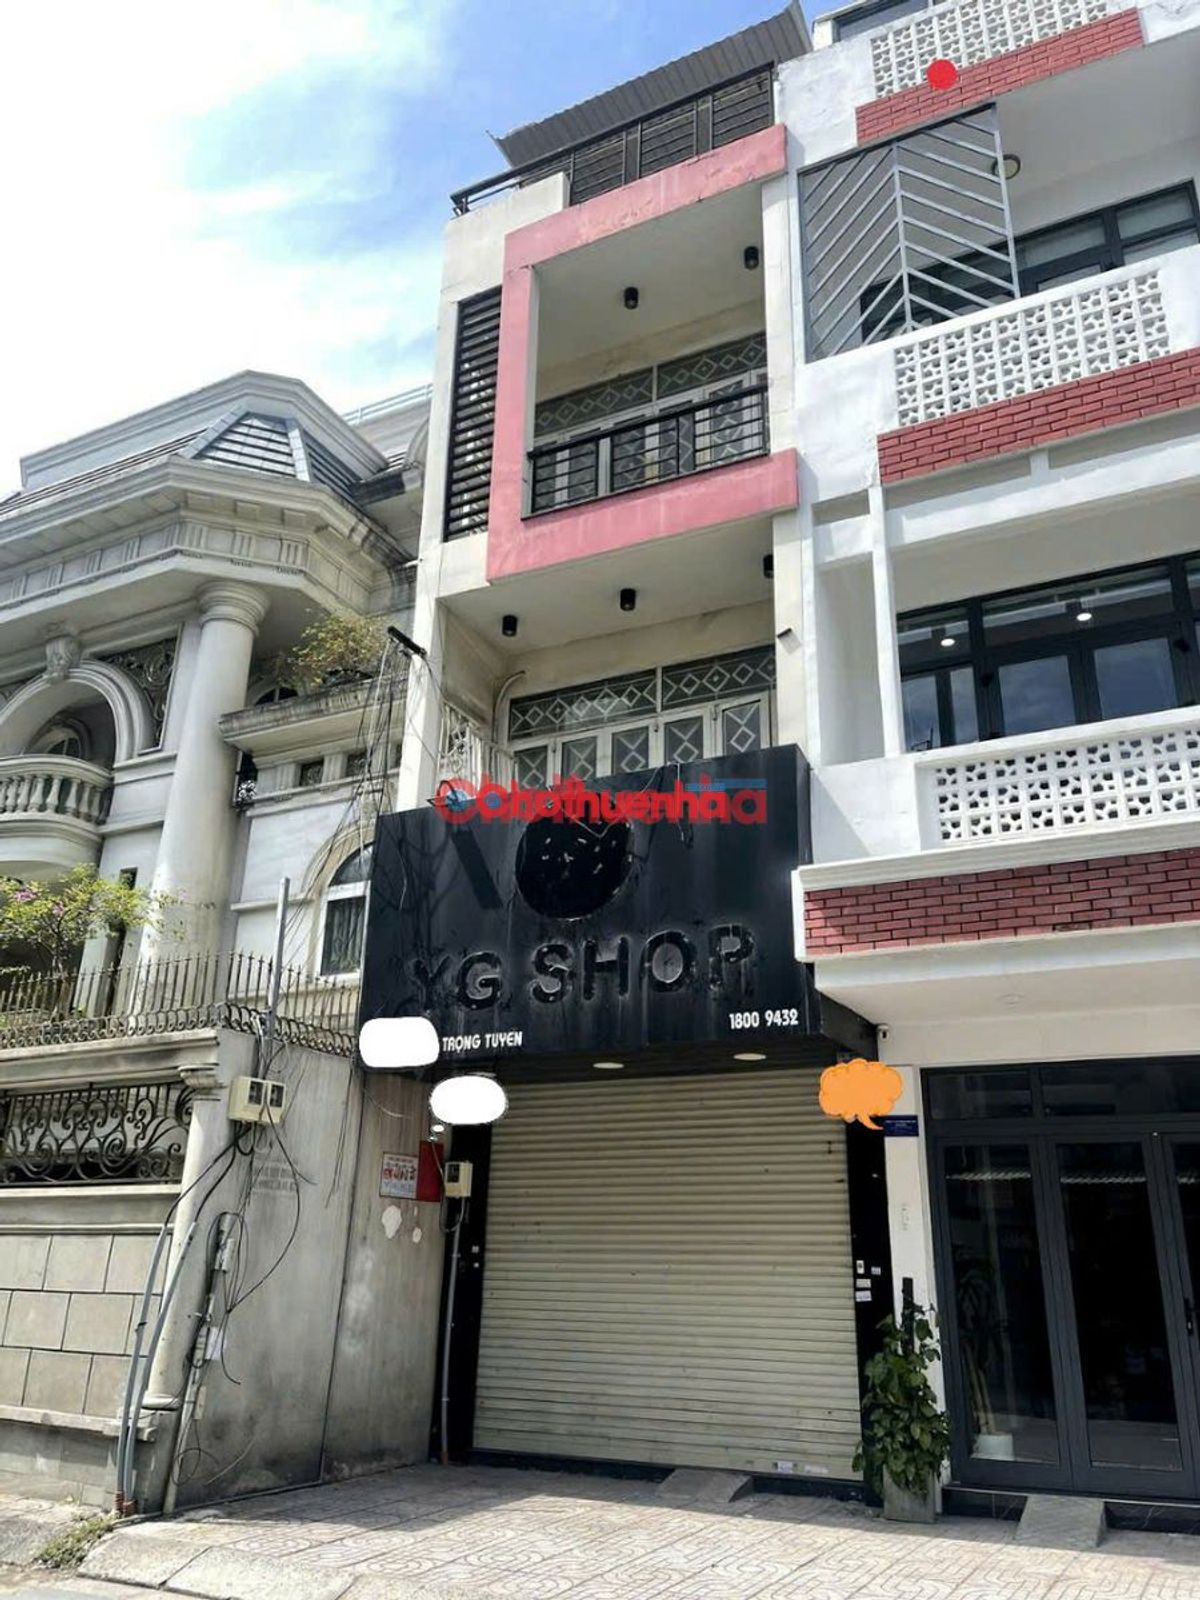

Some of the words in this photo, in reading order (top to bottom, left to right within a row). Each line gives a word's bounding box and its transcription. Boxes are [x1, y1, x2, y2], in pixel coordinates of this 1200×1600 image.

[530, 924, 755, 1003] SHOP
[729, 1012, 760, 1029] 1800
[765, 1008, 799, 1026] 9432
[442, 1034, 481, 1053] TRỌNG
